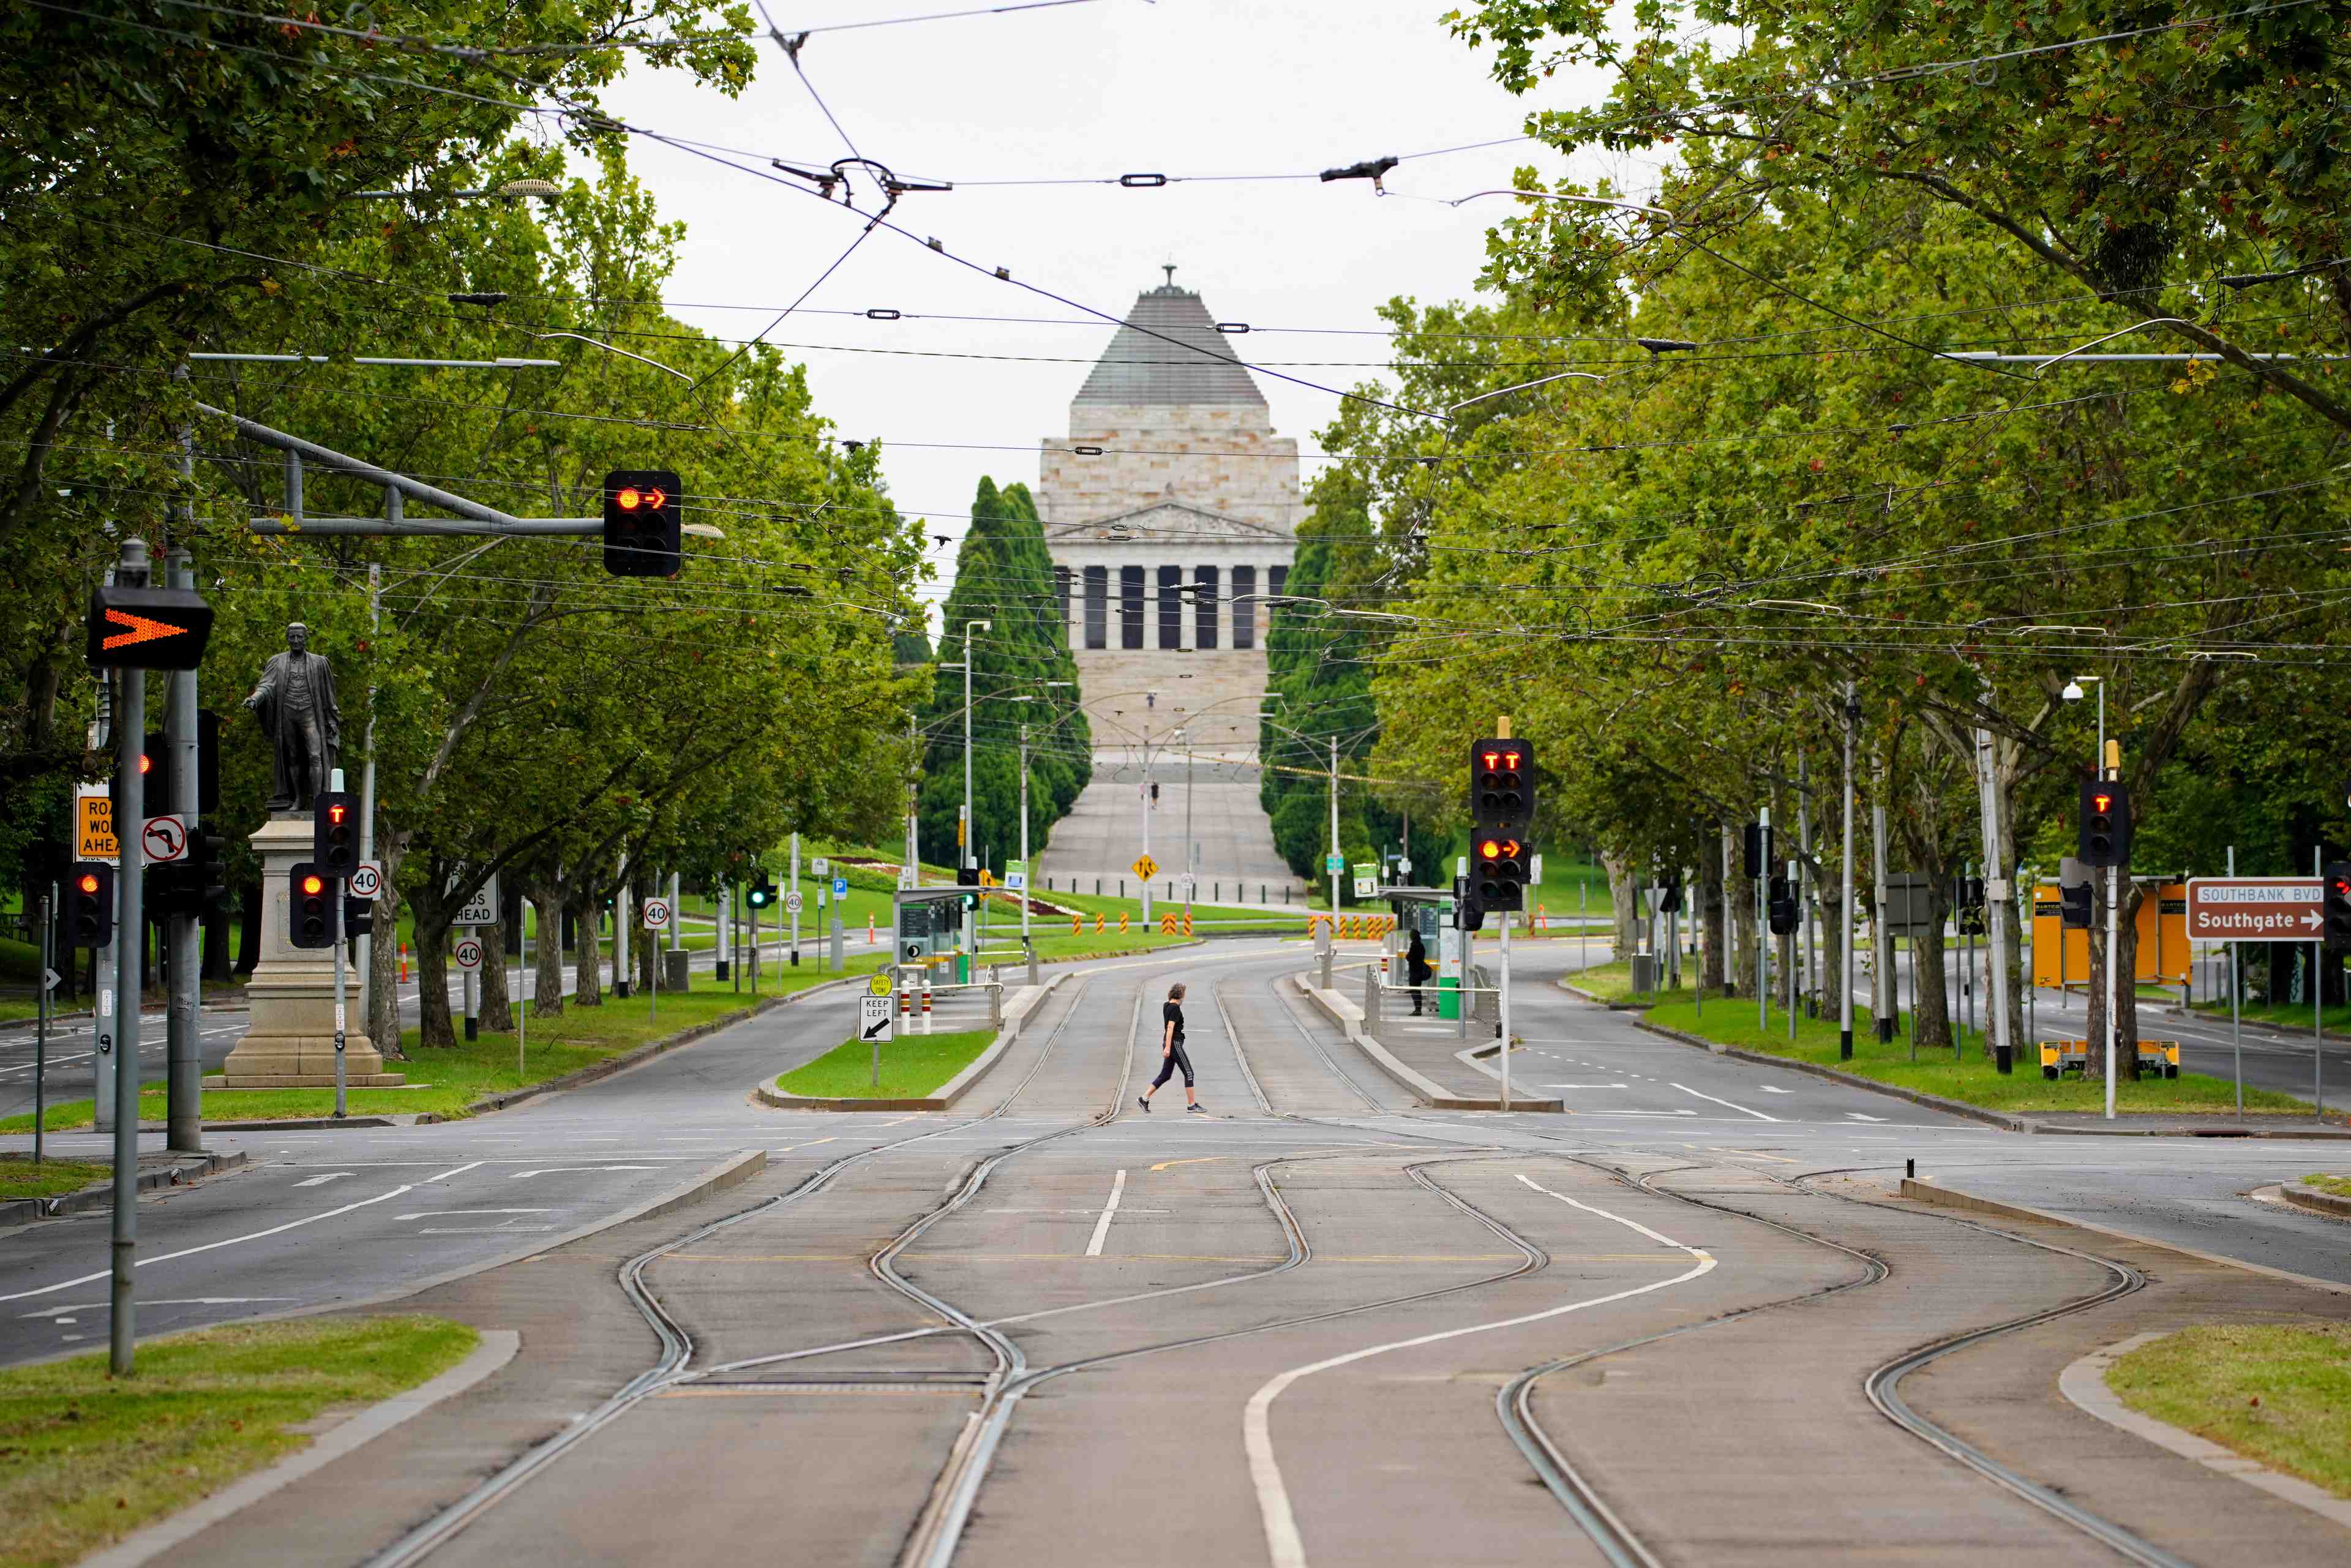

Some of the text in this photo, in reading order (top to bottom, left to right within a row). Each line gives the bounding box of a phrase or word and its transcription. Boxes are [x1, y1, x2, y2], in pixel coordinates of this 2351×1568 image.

[89, 802, 112, 815] RO
[89, 820, 110, 833] WO
[83, 839, 121, 852] AHE
[354, 873, 377, 888] 40
[836, 882, 843, 891] P
[2202, 888, 2320, 901] SOUTHBANK BVD
[789, 898, 800, 906] 40
[456, 909, 490, 920] HEAD
[648, 908, 665, 919] 40
[2198, 911, 2294, 932] Southgate
[459, 948, 478, 961] 40
